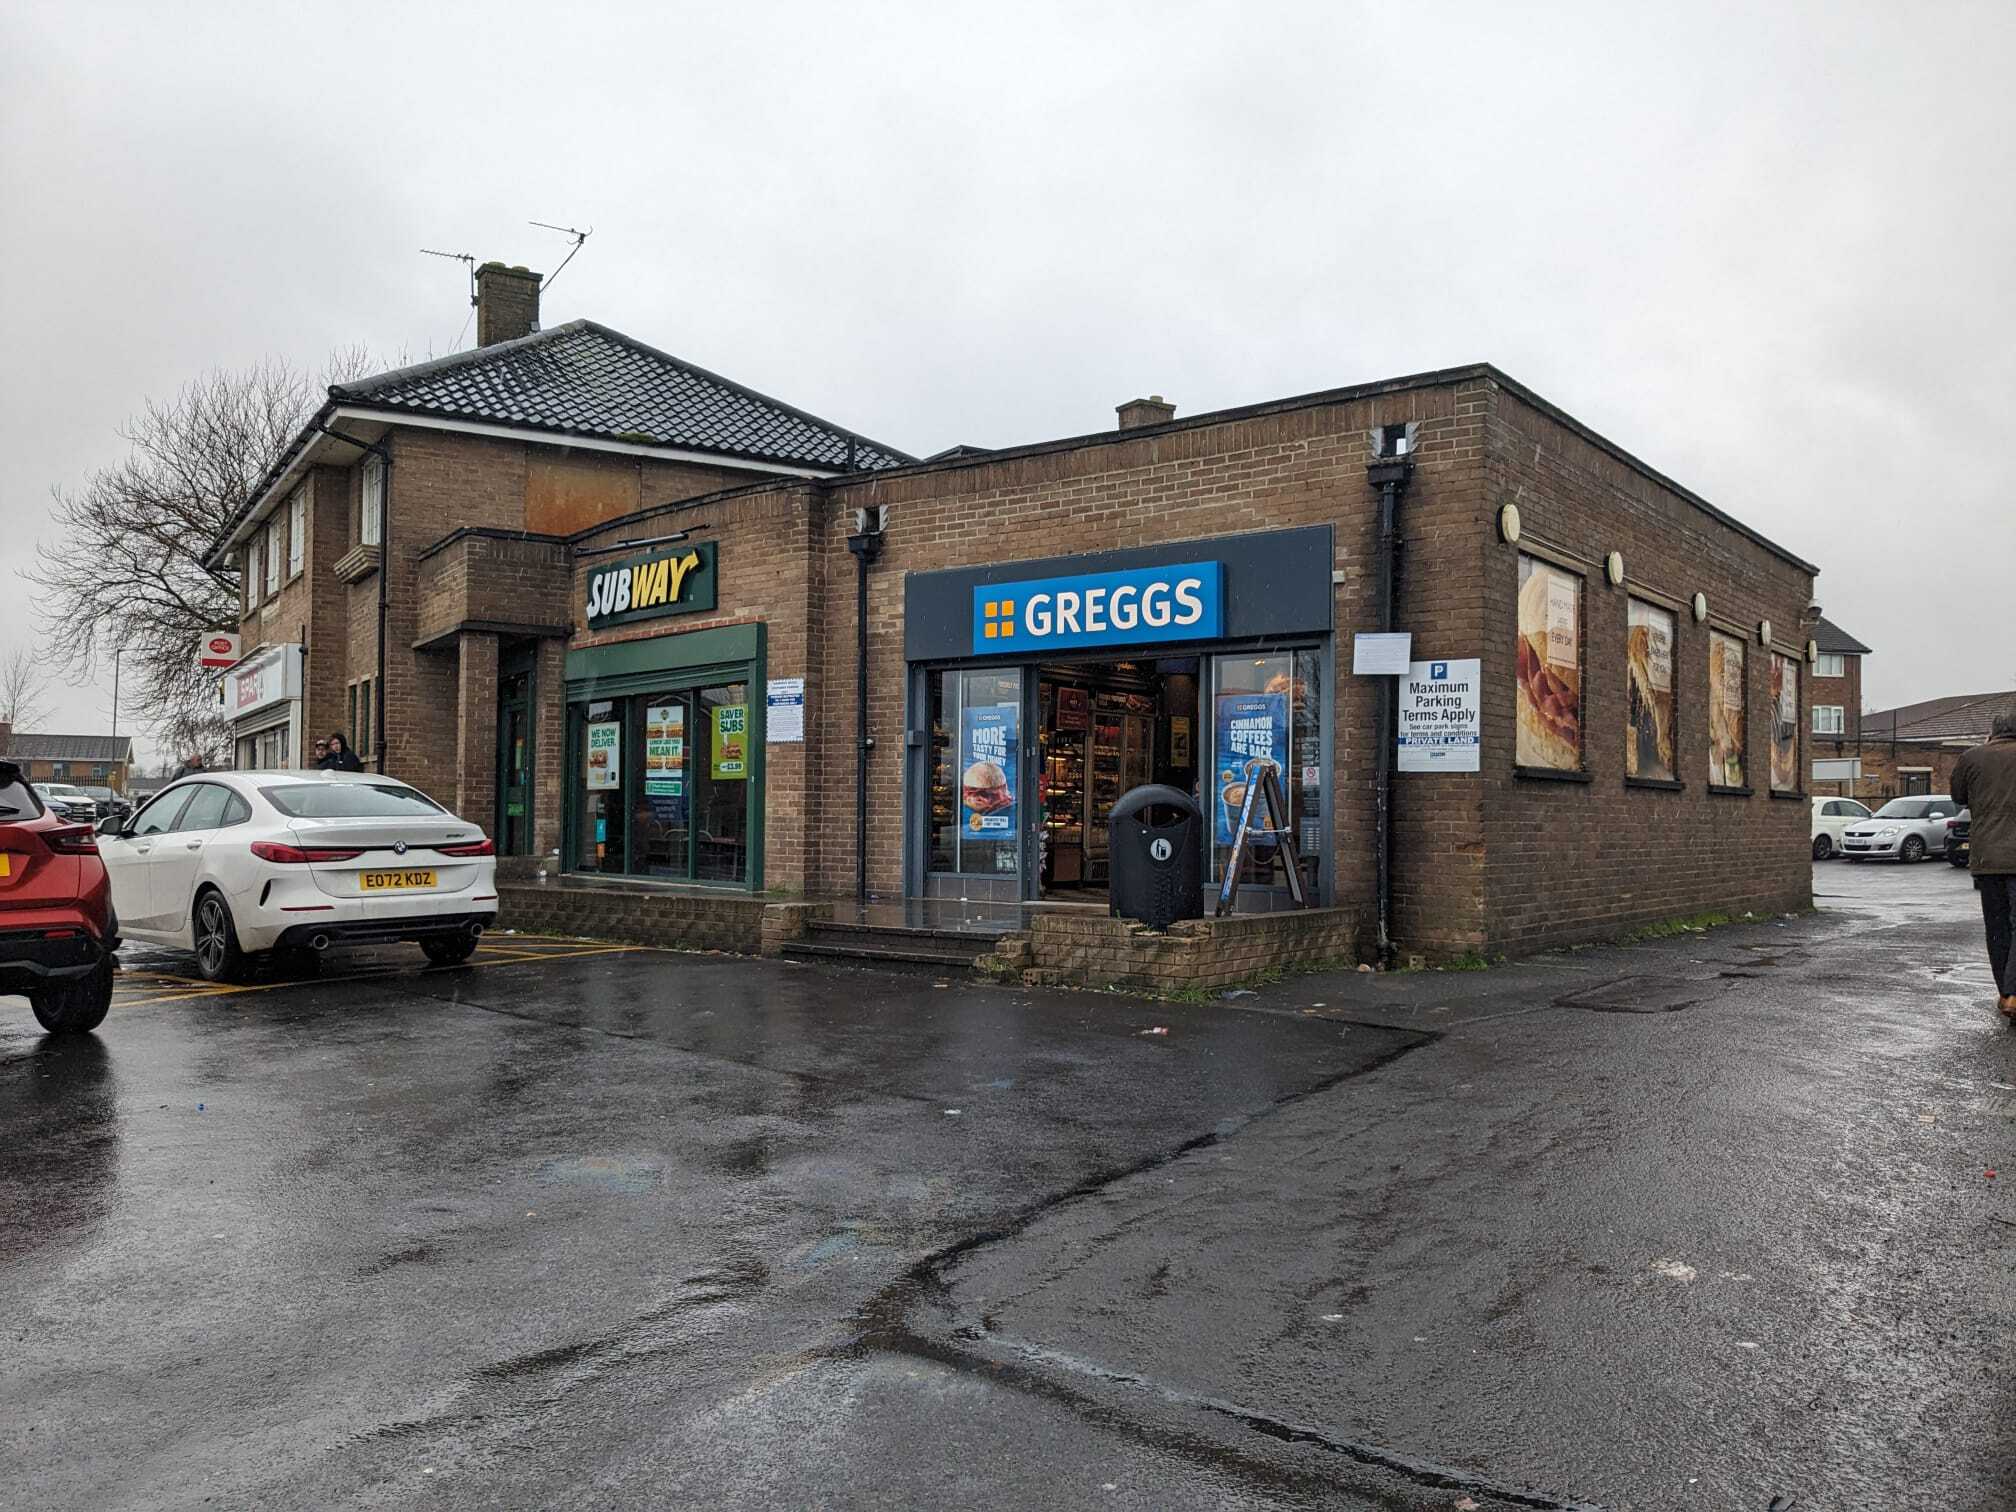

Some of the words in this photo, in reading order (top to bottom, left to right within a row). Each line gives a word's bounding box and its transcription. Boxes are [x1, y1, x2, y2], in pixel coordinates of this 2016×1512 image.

[586, 550, 699, 620] SUBWAY
[1025, 578, 1203, 637] GREGGS
[1409, 681, 1469, 695] Maximum
[1415, 695, 1462, 709] Parking
[720, 709, 744, 720] SAVER
[1402, 709, 1439, 721] Terms
[1441, 708, 1476, 723] Apply
[720, 720, 744, 732] SUBS
[1230, 717, 1273, 730] CINNAMON
[1434, 723, 1449, 731] park
[1451, 723, 1468, 731] signs
[591, 729, 601, 738] WE
[601, 728, 616, 737] NOW
[972, 726, 1007, 746] MORE
[1230, 730, 1273, 746] COFFEES
[591, 738, 616, 748] DELIVER.
[1405, 737, 1445, 745] PRIVATE
[1447, 736, 1475, 744] LAND
[649, 747, 670, 756] MEAN
[973, 743, 992, 754] TASTY
[994, 745, 1007, 756] FOR
[1231, 742, 1248, 754] ARE
[1250, 745, 1273, 759] BACK
[366, 874, 402, 888] EO72
[405, 872, 431, 886] KDZ
